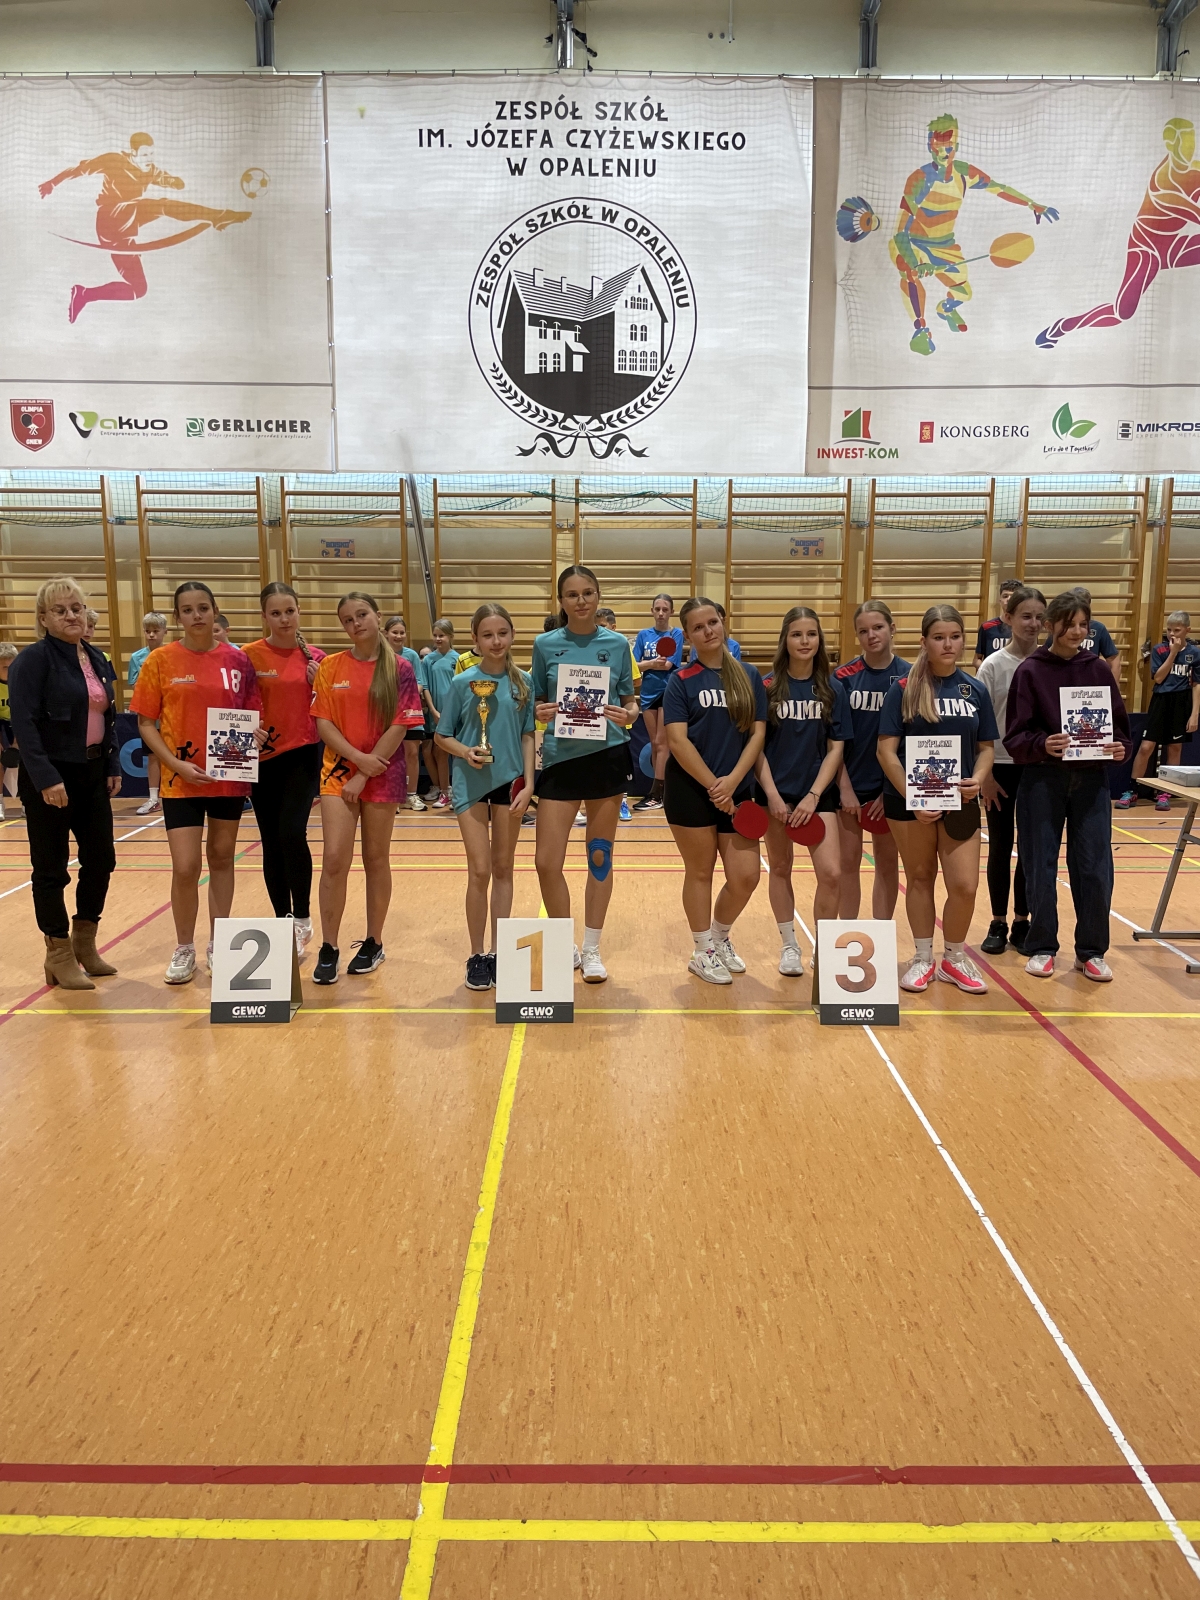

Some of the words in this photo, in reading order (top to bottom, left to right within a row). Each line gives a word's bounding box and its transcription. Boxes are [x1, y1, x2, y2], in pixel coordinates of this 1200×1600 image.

[495, 94, 583, 120] ZESPÓŁ
[594, 95, 668, 122] SZKÓŁ
[418, 128, 453, 148] IM.
[466, 122, 554, 148] JÓZEFA
[565, 126, 746, 151] CZYŻEWSKIEGO
[506, 157, 527, 176] W
[539, 157, 657, 178] OPALENIU
[475, 232, 525, 309] ZESPÓŁ
[525, 200, 593, 234] SZKÓŁ
[601, 206, 620, 224] W
[624, 217, 690, 309] OPALENIU
[100, 416, 168, 430] akuo
[207, 419, 311, 433] GERLICHER
[940, 425, 1029, 438] KONGSBERG
[817, 447, 899, 459] INWEST-KOM
[220, 667, 242, 693] 18
[933, 698, 977, 717] LIMP
[229, 928, 272, 991] 2
[516, 930, 543, 991] 1
[834, 931, 878, 993] 3
[231, 1005, 266, 1016] GEWO
[520, 1006, 554, 1016] GEWO
[840, 1008, 875, 1018] GEWO
